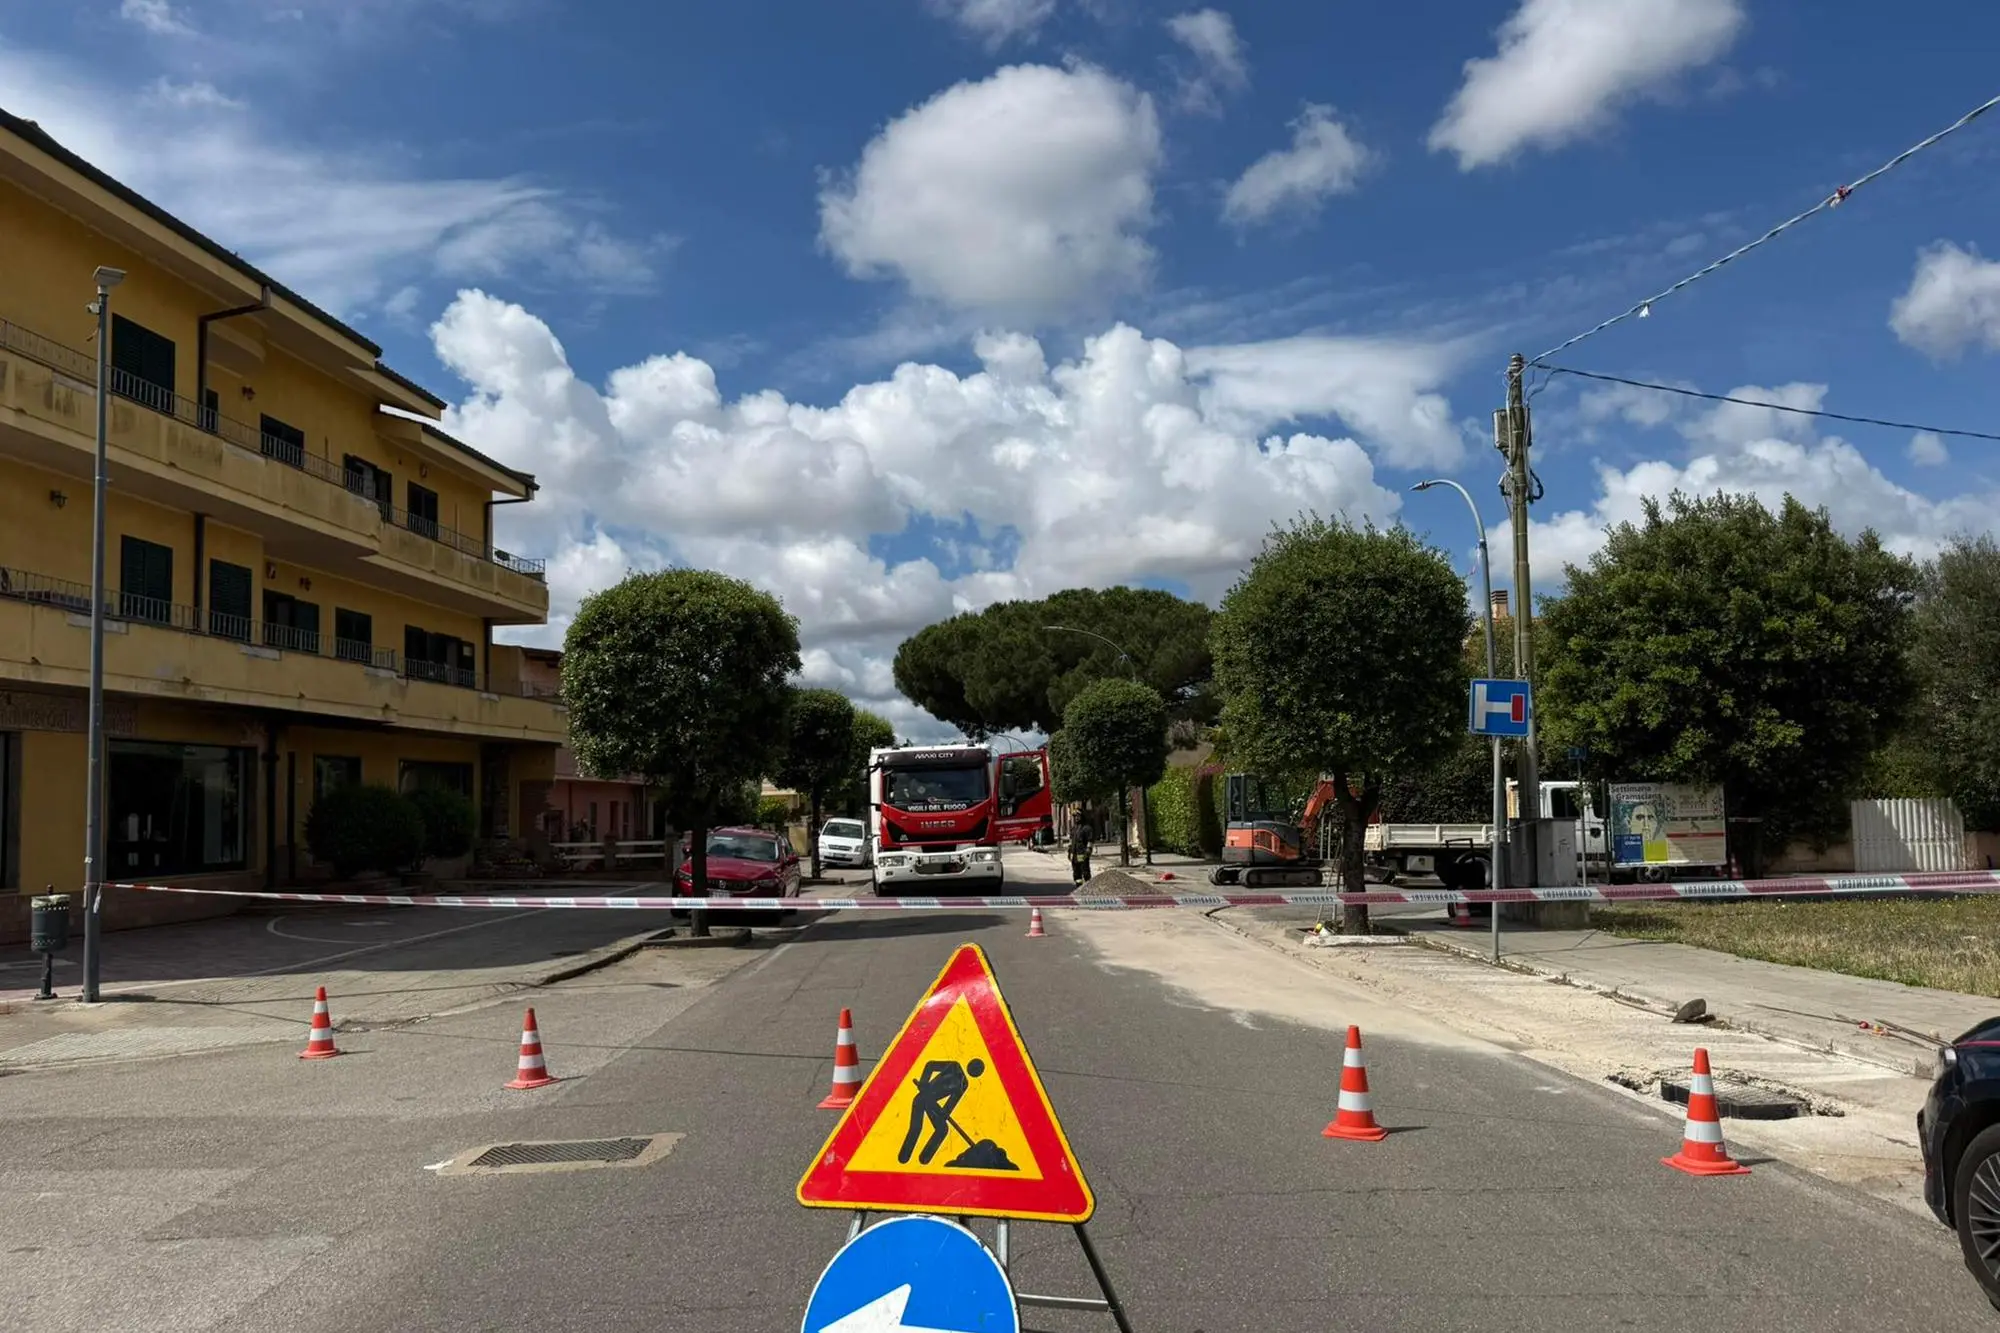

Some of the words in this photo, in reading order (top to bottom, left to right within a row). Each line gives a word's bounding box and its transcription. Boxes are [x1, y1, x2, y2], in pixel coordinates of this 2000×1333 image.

[914, 752, 937, 760] MAXI
[938, 751, 954, 759] CITY
[1611, 784, 1652, 794] Settimana
[920, 819, 956, 829] IVECO
